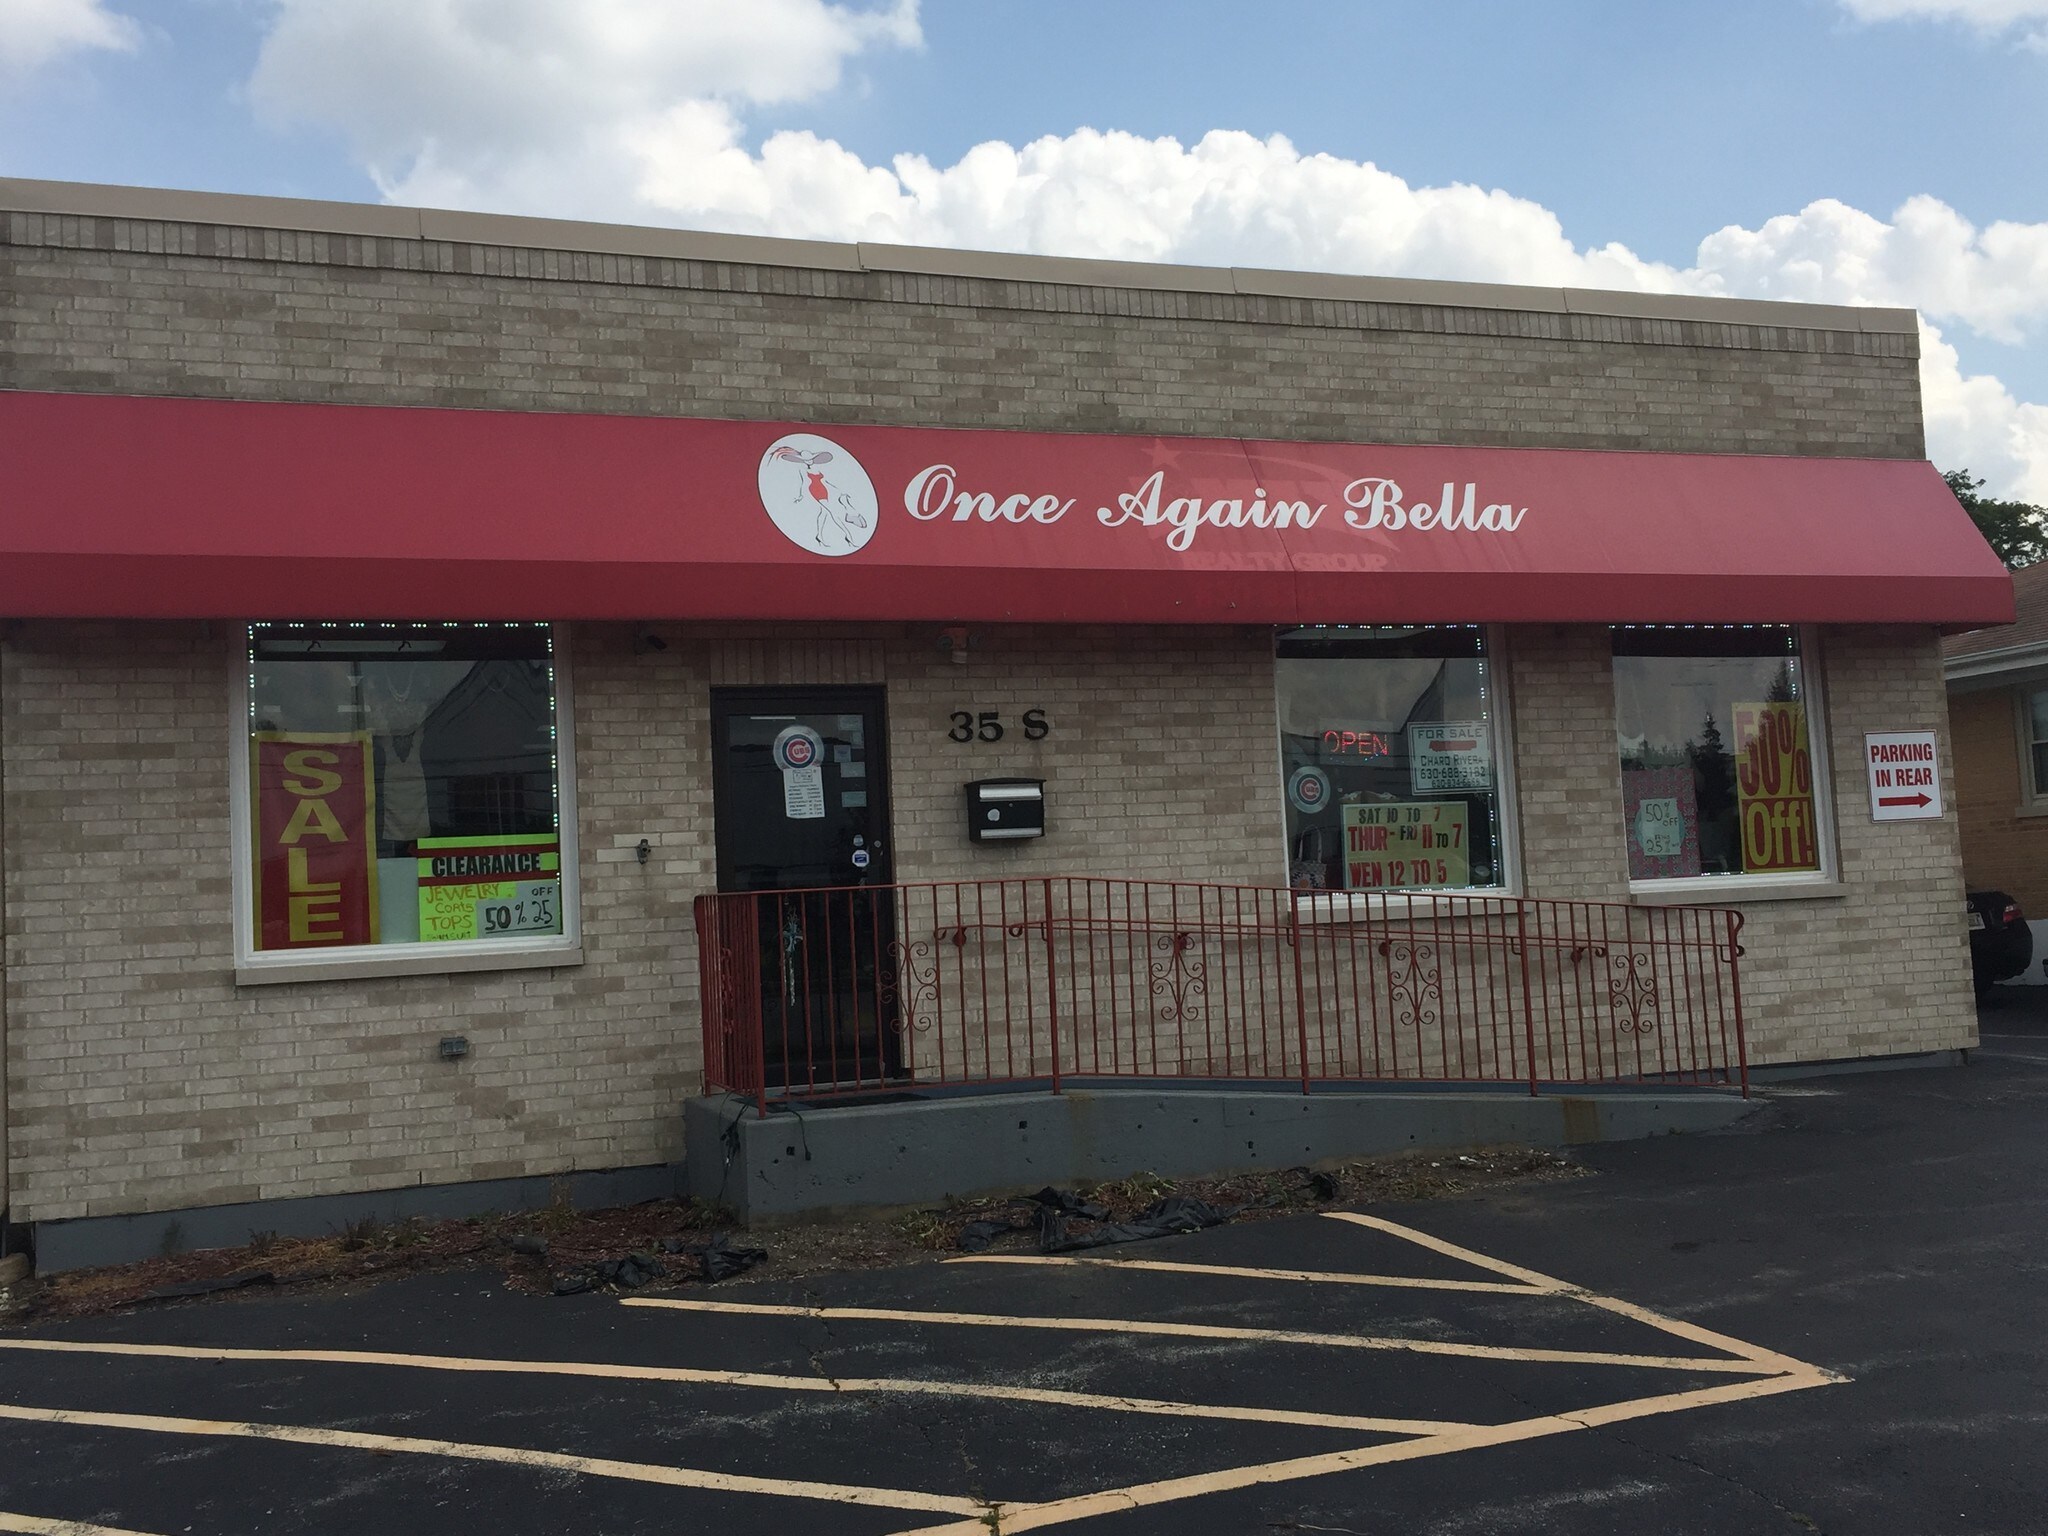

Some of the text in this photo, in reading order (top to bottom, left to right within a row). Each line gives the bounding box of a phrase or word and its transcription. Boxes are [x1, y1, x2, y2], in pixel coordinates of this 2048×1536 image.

[903, 463, 1528, 552] Once Again Bella
[948, 709, 1049, 743] 35 S
[1418, 728, 1482, 739] FOR SALE
[1324, 730, 1389, 755] OPEN
[1735, 707, 1810, 796] 50%
[1870, 743, 1933, 763] PARKING
[1875, 767, 1933, 788] IN REAR
[1358, 806, 1441, 824] SAT 10 TO 7
[278, 749, 349, 942] SALE
[1436, 833, 1449, 848] TO
[1452, 823, 1463, 849] 7
[1745, 800, 1814, 869] Off!
[432, 853, 541, 877] CLEARANCE
[1348, 858, 1448, 887] WEN 12 TO 5
[426, 883, 500, 904] JEWELRY
[531, 887, 553, 897] OFF
[425, 915, 472, 931] TOPS
